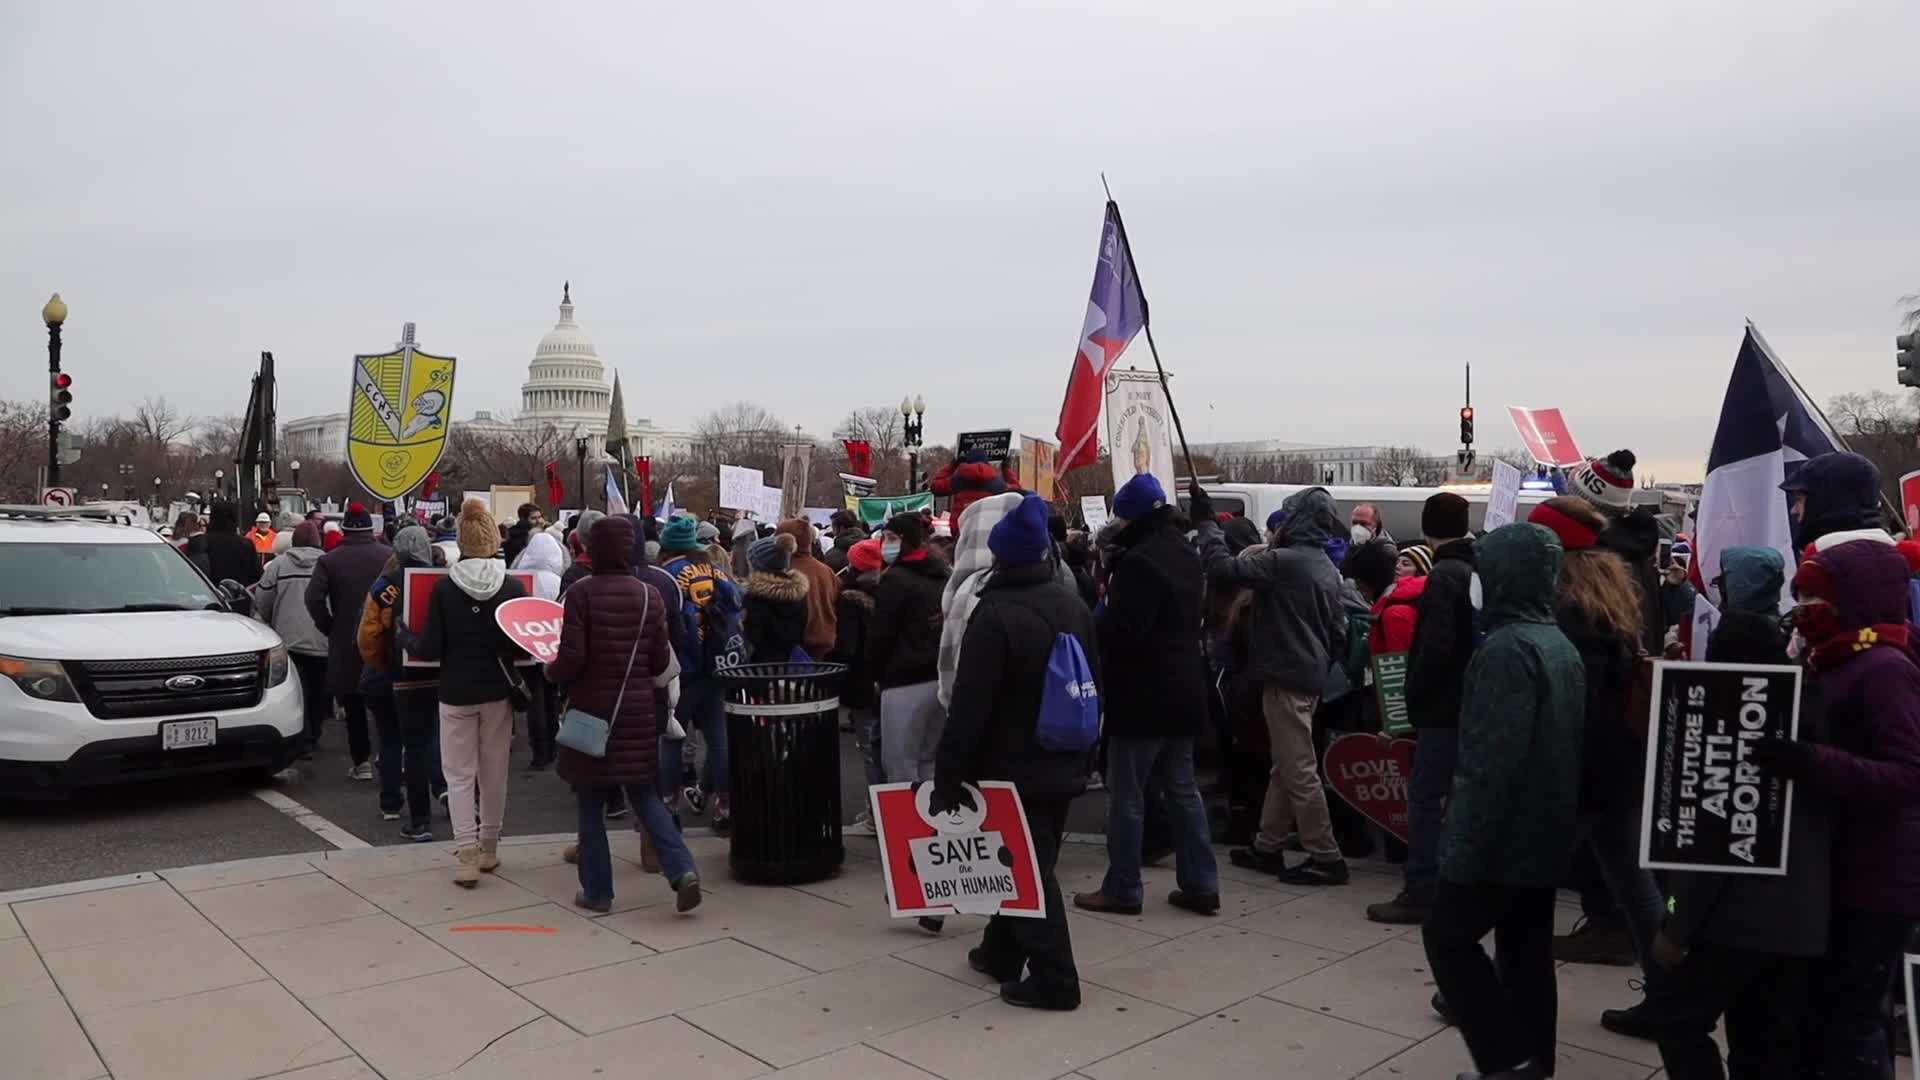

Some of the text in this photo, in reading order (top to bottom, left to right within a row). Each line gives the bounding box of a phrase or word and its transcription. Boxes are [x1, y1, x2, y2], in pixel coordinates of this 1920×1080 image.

[365, 383, 393, 421] CCHS
[959, 447, 1008, 458] ATION
[677, 564, 728, 592] RUSADERS
[380, 583, 401, 605] CR
[513, 617, 563, 637] LOV
[533, 640, 560, 656] BO
[1378, 655, 1406, 689] LIFE
[1340, 759, 1400, 779] LOVE
[1677, 685, 1706, 848] THE FUTURE IS
[1702, 719, 1733, 819] ANTI-
[1729, 677, 1769, 863] ABORTION
[928, 837, 991, 866] SAVE
[958, 864, 973, 874] the
[924, 874, 1013, 900] BABY HUMANS
